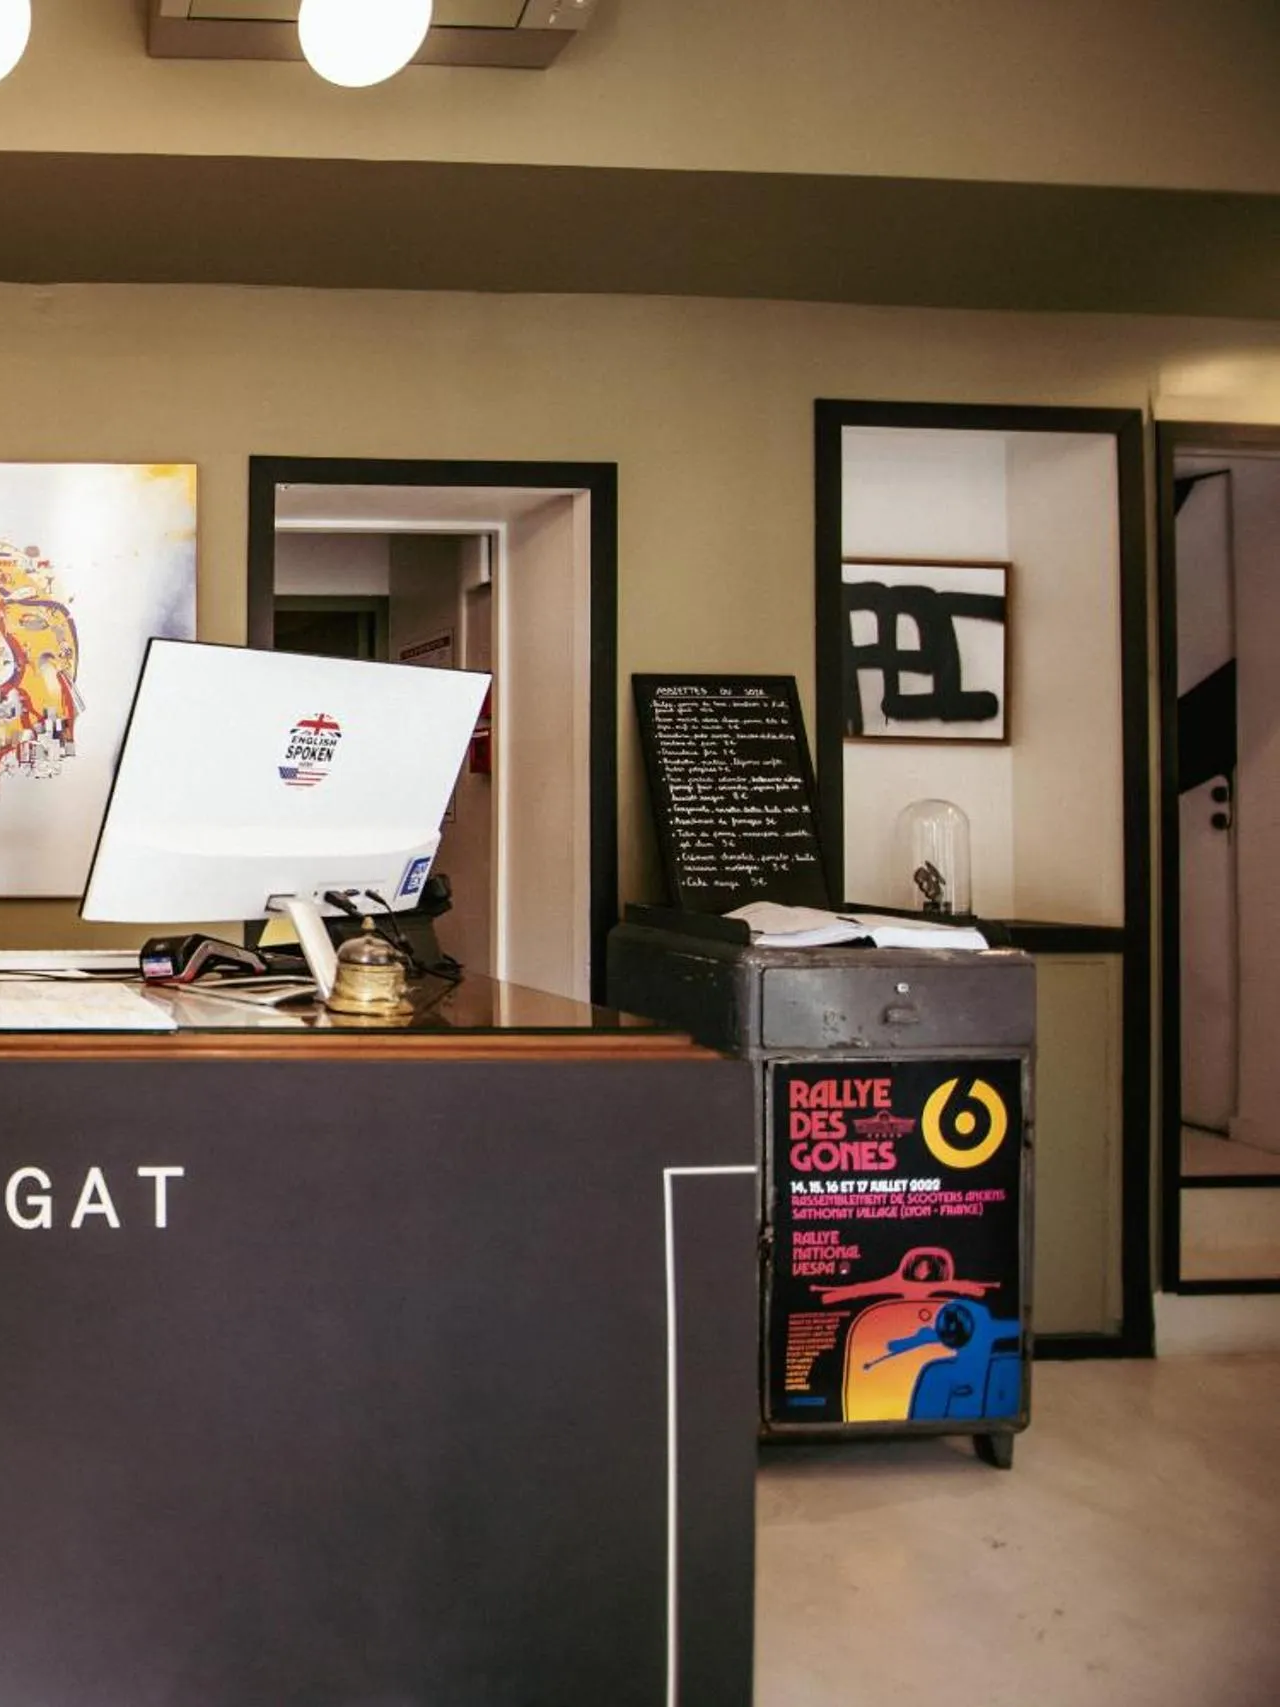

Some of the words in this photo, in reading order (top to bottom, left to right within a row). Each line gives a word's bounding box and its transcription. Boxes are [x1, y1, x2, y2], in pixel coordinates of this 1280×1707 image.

[291, 735, 337, 746] ENGLISH
[285, 745, 335, 762] SPOKEN
[790, 1079, 891, 1109] RALLYE
[790, 1110, 847, 1140] DES
[790, 1141, 897, 1172] GONES
[826, 1181, 839, 1193] 16
[840, 1181, 855, 1192] ET
[856, 1180, 868, 1192] 17
[870, 1179, 907, 1192] JUILLET
[791, 1194, 887, 1207] RASSEMBLEMENT
[890, 1193, 904, 1204] DE
[907, 1191, 963, 1204] SCOOTERS
[856, 1206, 899, 1219] VILLAGE
[793, 1230, 839, 1246] RALLYE
[793, 1245, 861, 1260] NATIONAL
[793, 1260, 835, 1276] VESPA
